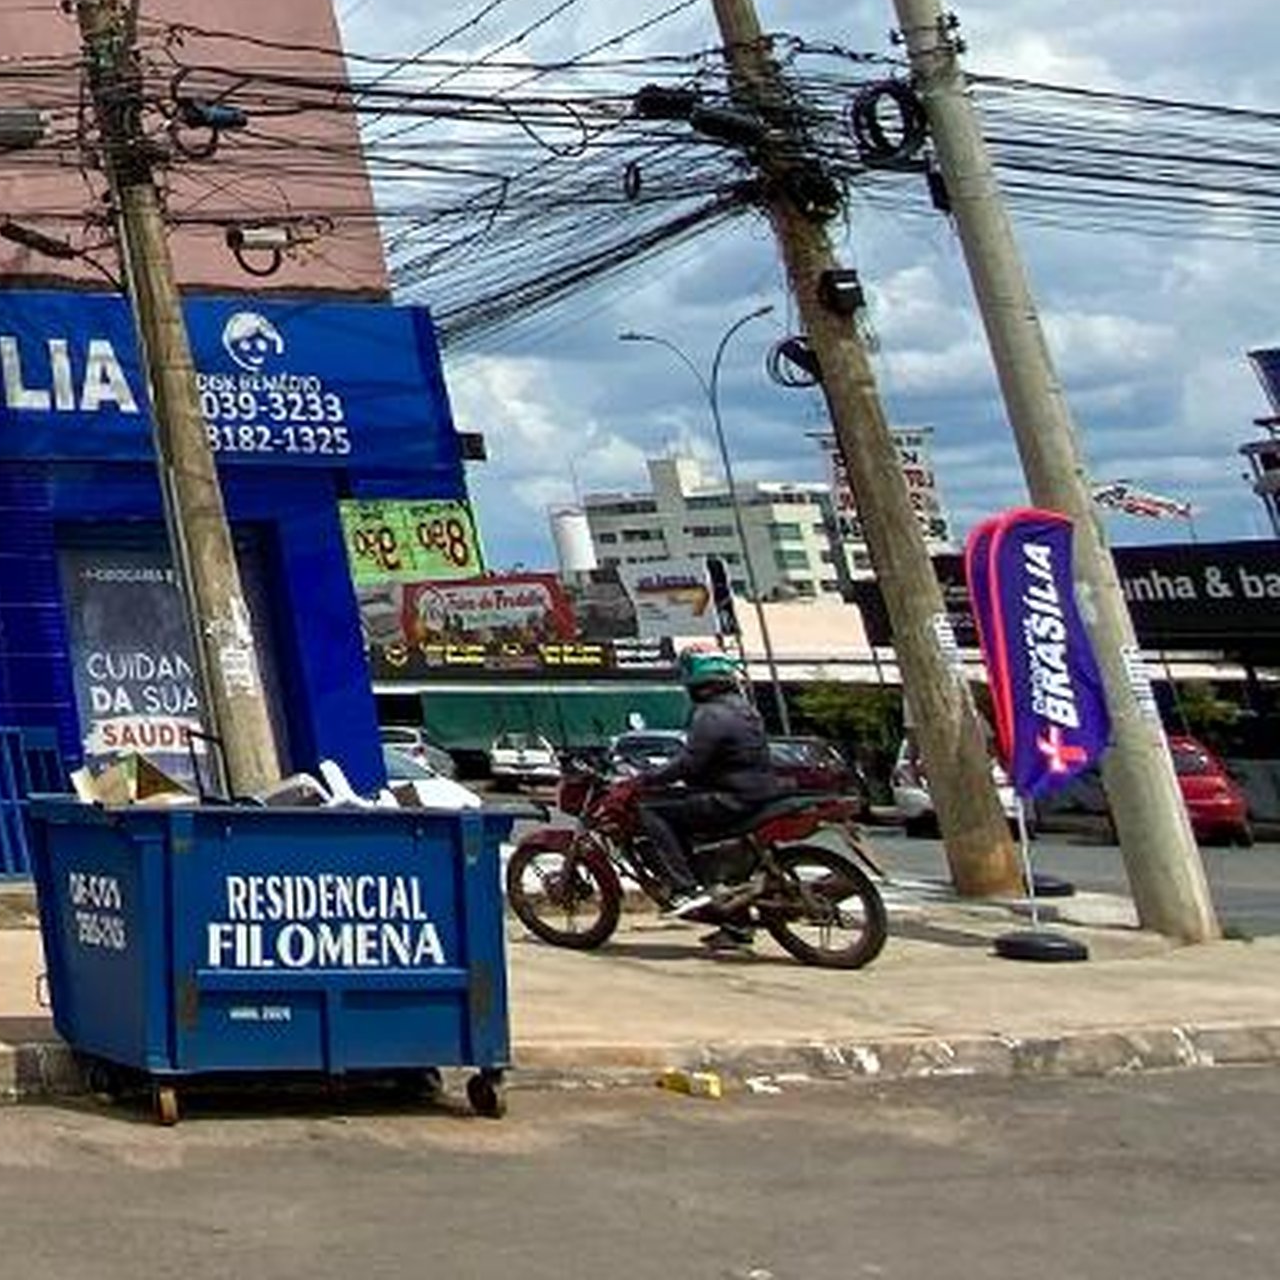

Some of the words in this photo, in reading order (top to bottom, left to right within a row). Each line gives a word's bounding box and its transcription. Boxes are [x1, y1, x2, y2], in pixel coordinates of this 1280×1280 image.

[202, 393, 344, 422] 039-3233
[205, 425, 352, 455] 8182-1325
[1206, 566, 1233, 599] &
[1023, 543, 1080, 728] BRASÍLIA
[87, 652, 194, 681] CUIDAN
[90, 685, 133, 713] DA
[226, 873, 427, 921] RESIDENCIAL
[206, 922, 447, 968] FILOMENA
